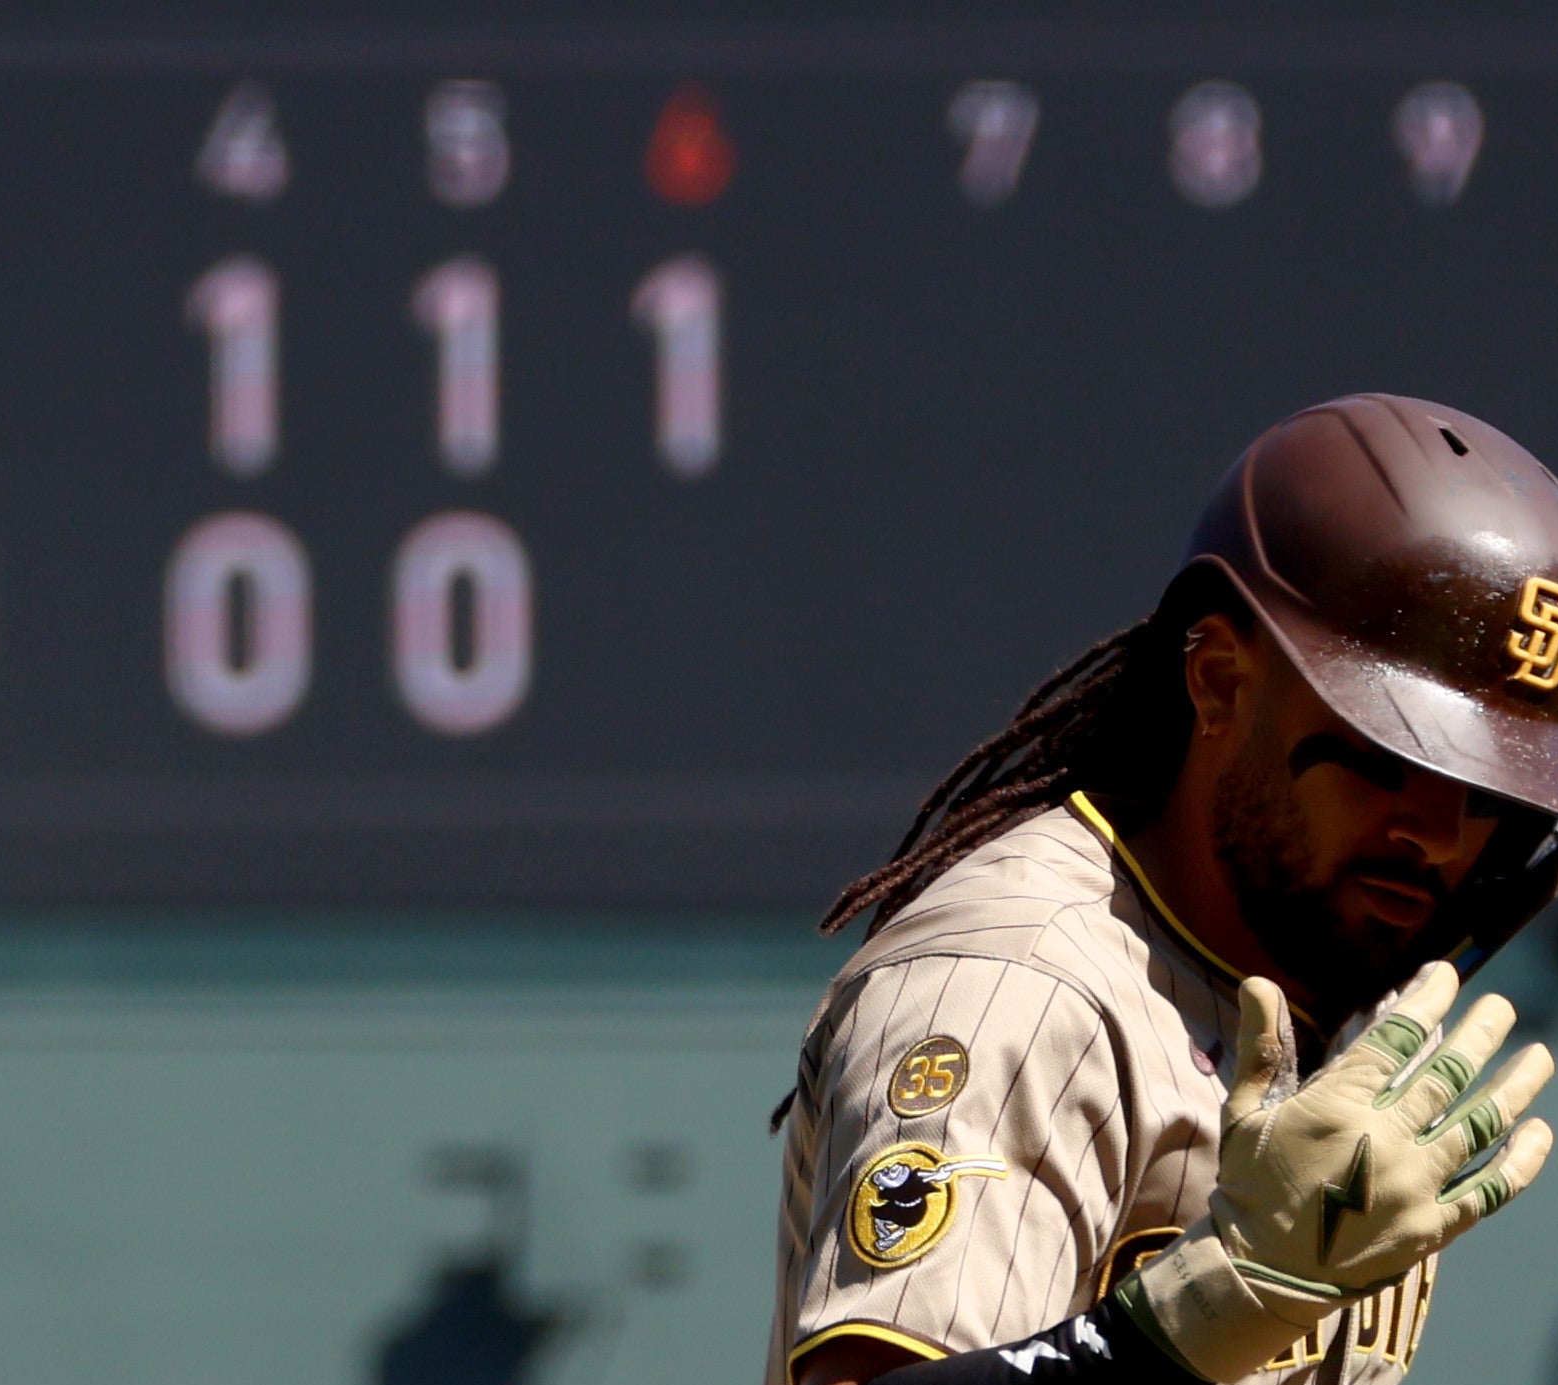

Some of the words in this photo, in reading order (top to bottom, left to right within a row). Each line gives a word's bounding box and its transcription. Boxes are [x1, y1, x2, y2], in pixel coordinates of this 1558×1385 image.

[200, 84, 288, 198] 4
[426, 82, 509, 200] 5
[950, 80, 1038, 196] 7
[1170, 82, 1260, 200] 8
[1396, 82, 1482, 198] 9
[187, 262, 278, 469] 1
[413, 263, 500, 470] 1
[633, 263, 721, 470] 1
[167, 513, 312, 732] 0
[393, 513, 533, 732] 0
[899, 1053, 961, 1099] 35
